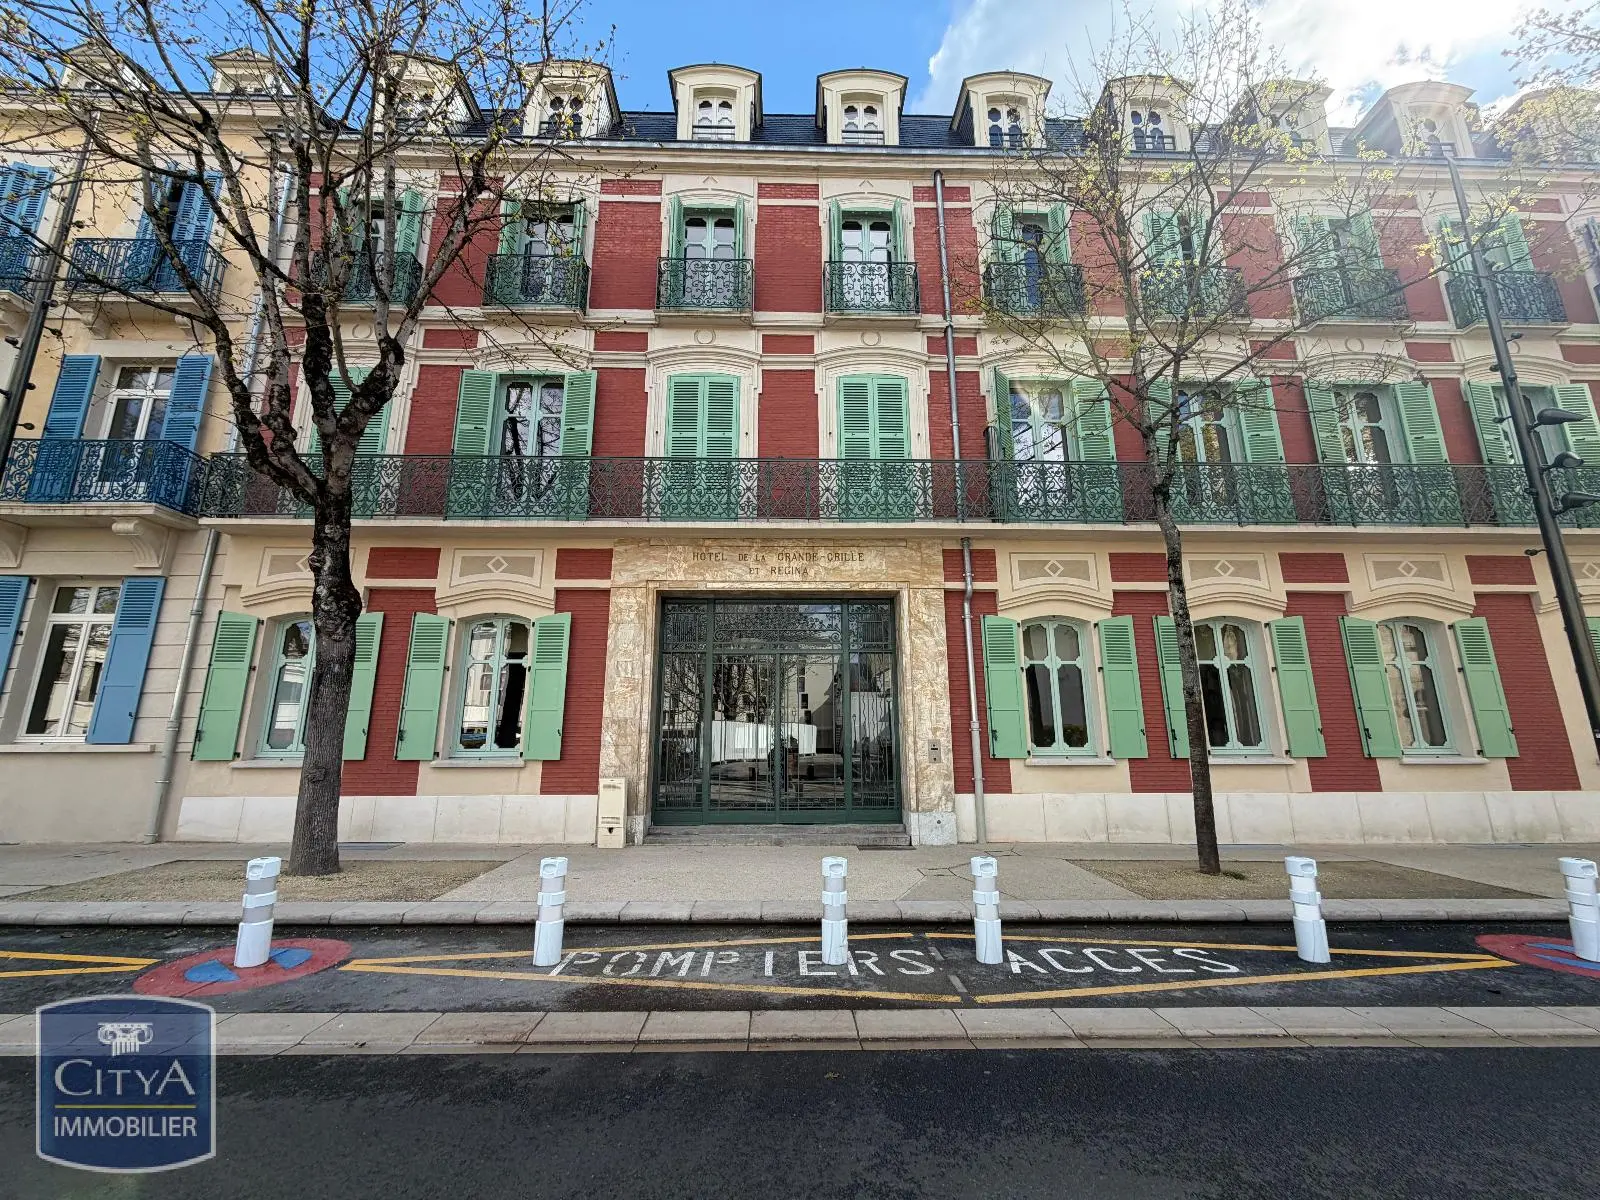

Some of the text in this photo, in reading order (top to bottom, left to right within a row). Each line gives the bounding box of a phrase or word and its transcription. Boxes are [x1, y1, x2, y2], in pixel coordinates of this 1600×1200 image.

[738, 553, 749, 562] DE
[755, 554, 766, 562] LA
[749, 566, 809, 576] ET REGINA
[548, 948, 1240, 977] POMPIERS ACCES
